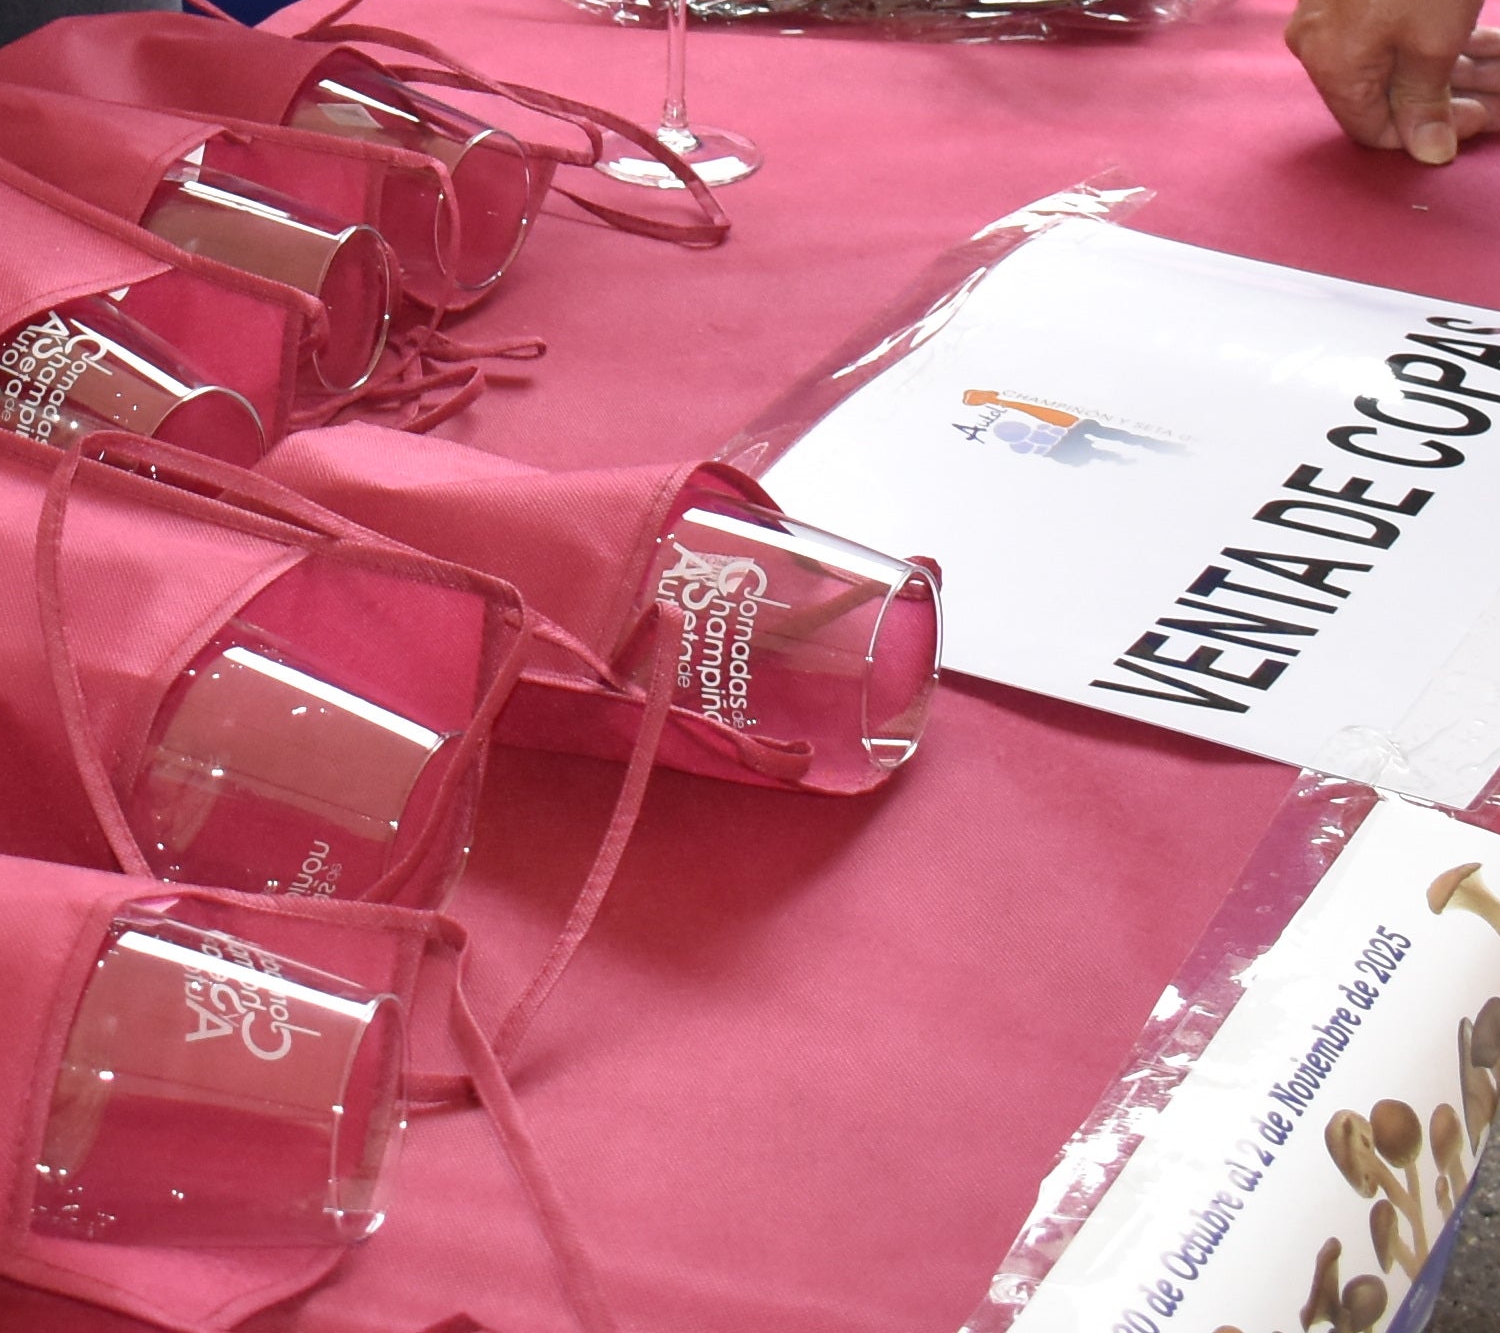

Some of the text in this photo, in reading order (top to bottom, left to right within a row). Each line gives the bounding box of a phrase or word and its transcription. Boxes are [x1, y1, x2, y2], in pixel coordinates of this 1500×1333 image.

[1088, 546, 1374, 714] VENTA
[1252, 463, 1436, 551] DE
[1354, 925, 1412, 985] 2025
[1338, 979, 1380, 1011] de
[1268, 1007, 1362, 1117] Noviembre
[1251, 1110, 1294, 1146] de
[1235, 1138, 1276, 1168] 2
[1224, 1158, 1264, 1193] al
[1159, 1190, 1245, 1281] Octubre
[1138, 1277, 1184, 1318] de
